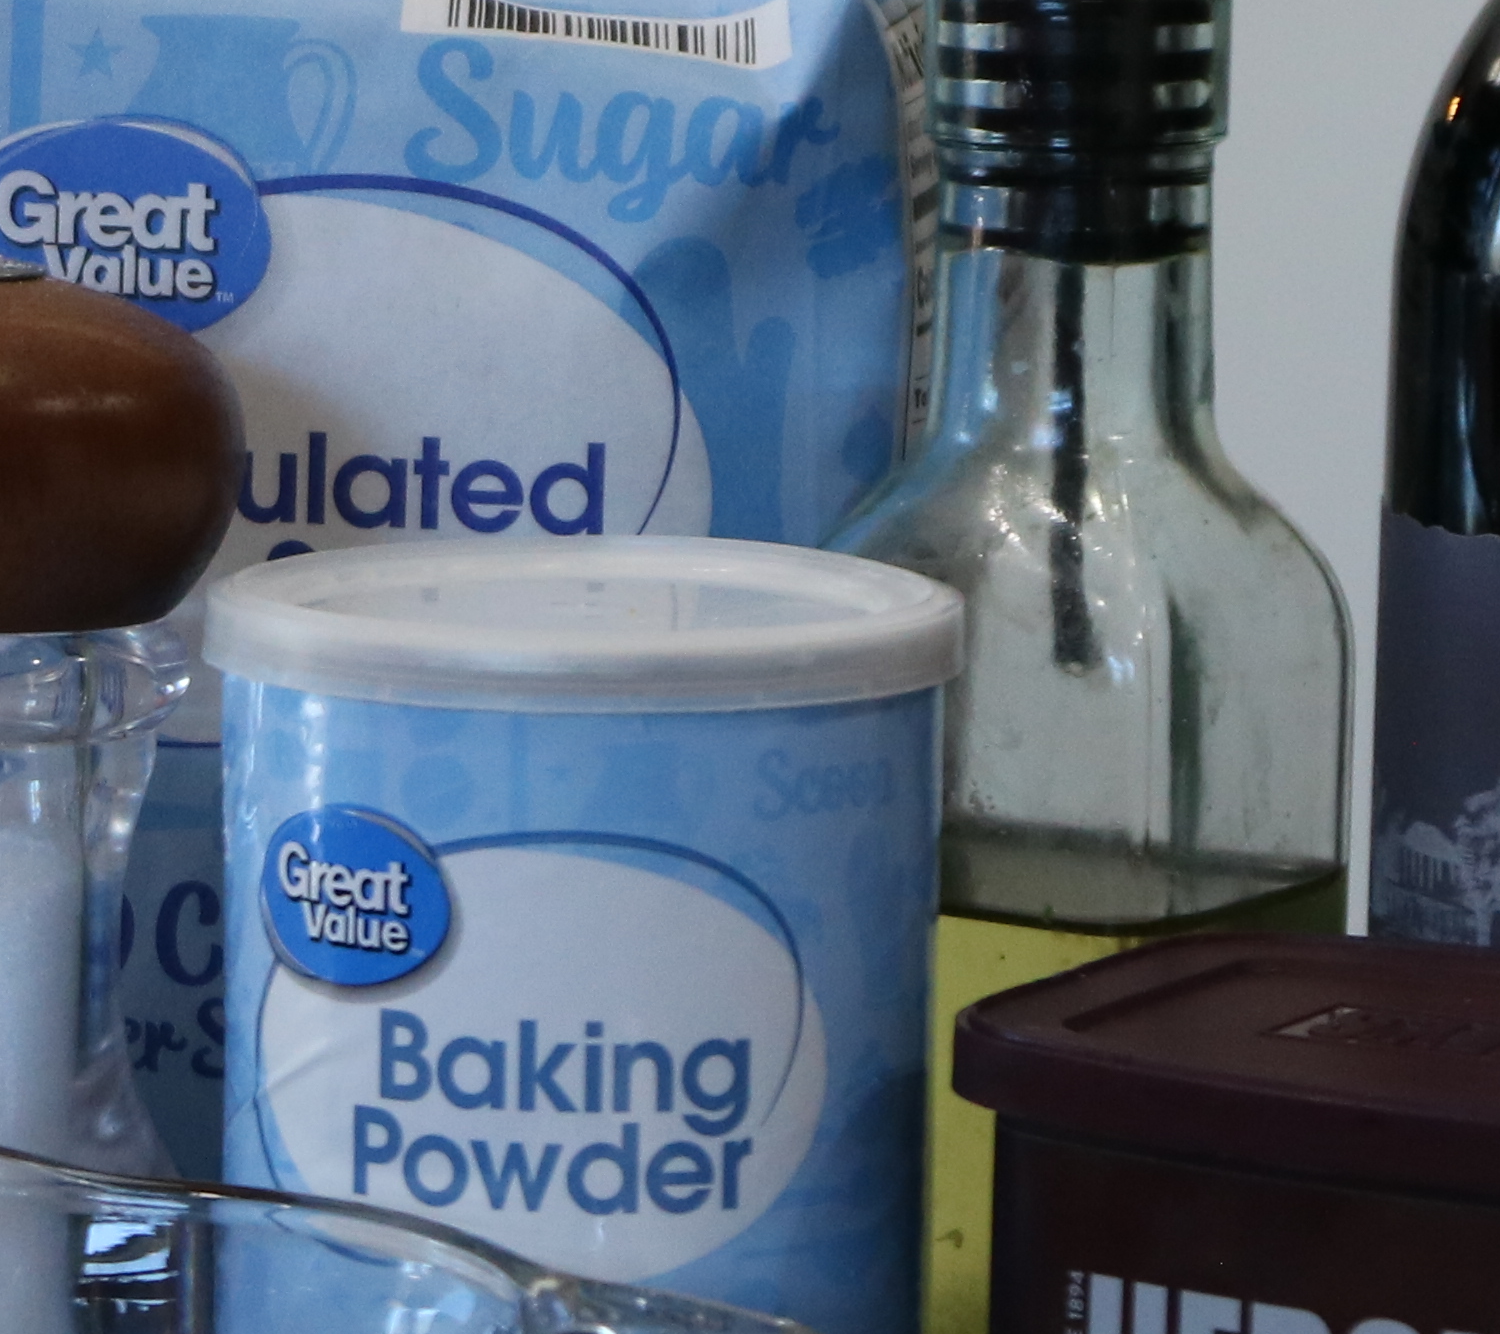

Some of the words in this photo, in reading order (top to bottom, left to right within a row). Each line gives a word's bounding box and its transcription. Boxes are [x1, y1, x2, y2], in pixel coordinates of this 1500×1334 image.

[404, 37, 840, 222] Sugar
[45, 244, 214, 298] Value
[237, 431, 605, 535] ulated
[279, 840, 411, 914] Great
[303, 902, 410, 952] Value
[379, 1009, 751, 1137] Baking
[353, 1106, 754, 1216] Powder
[1067, 1271, 1085, 1320] 1894
